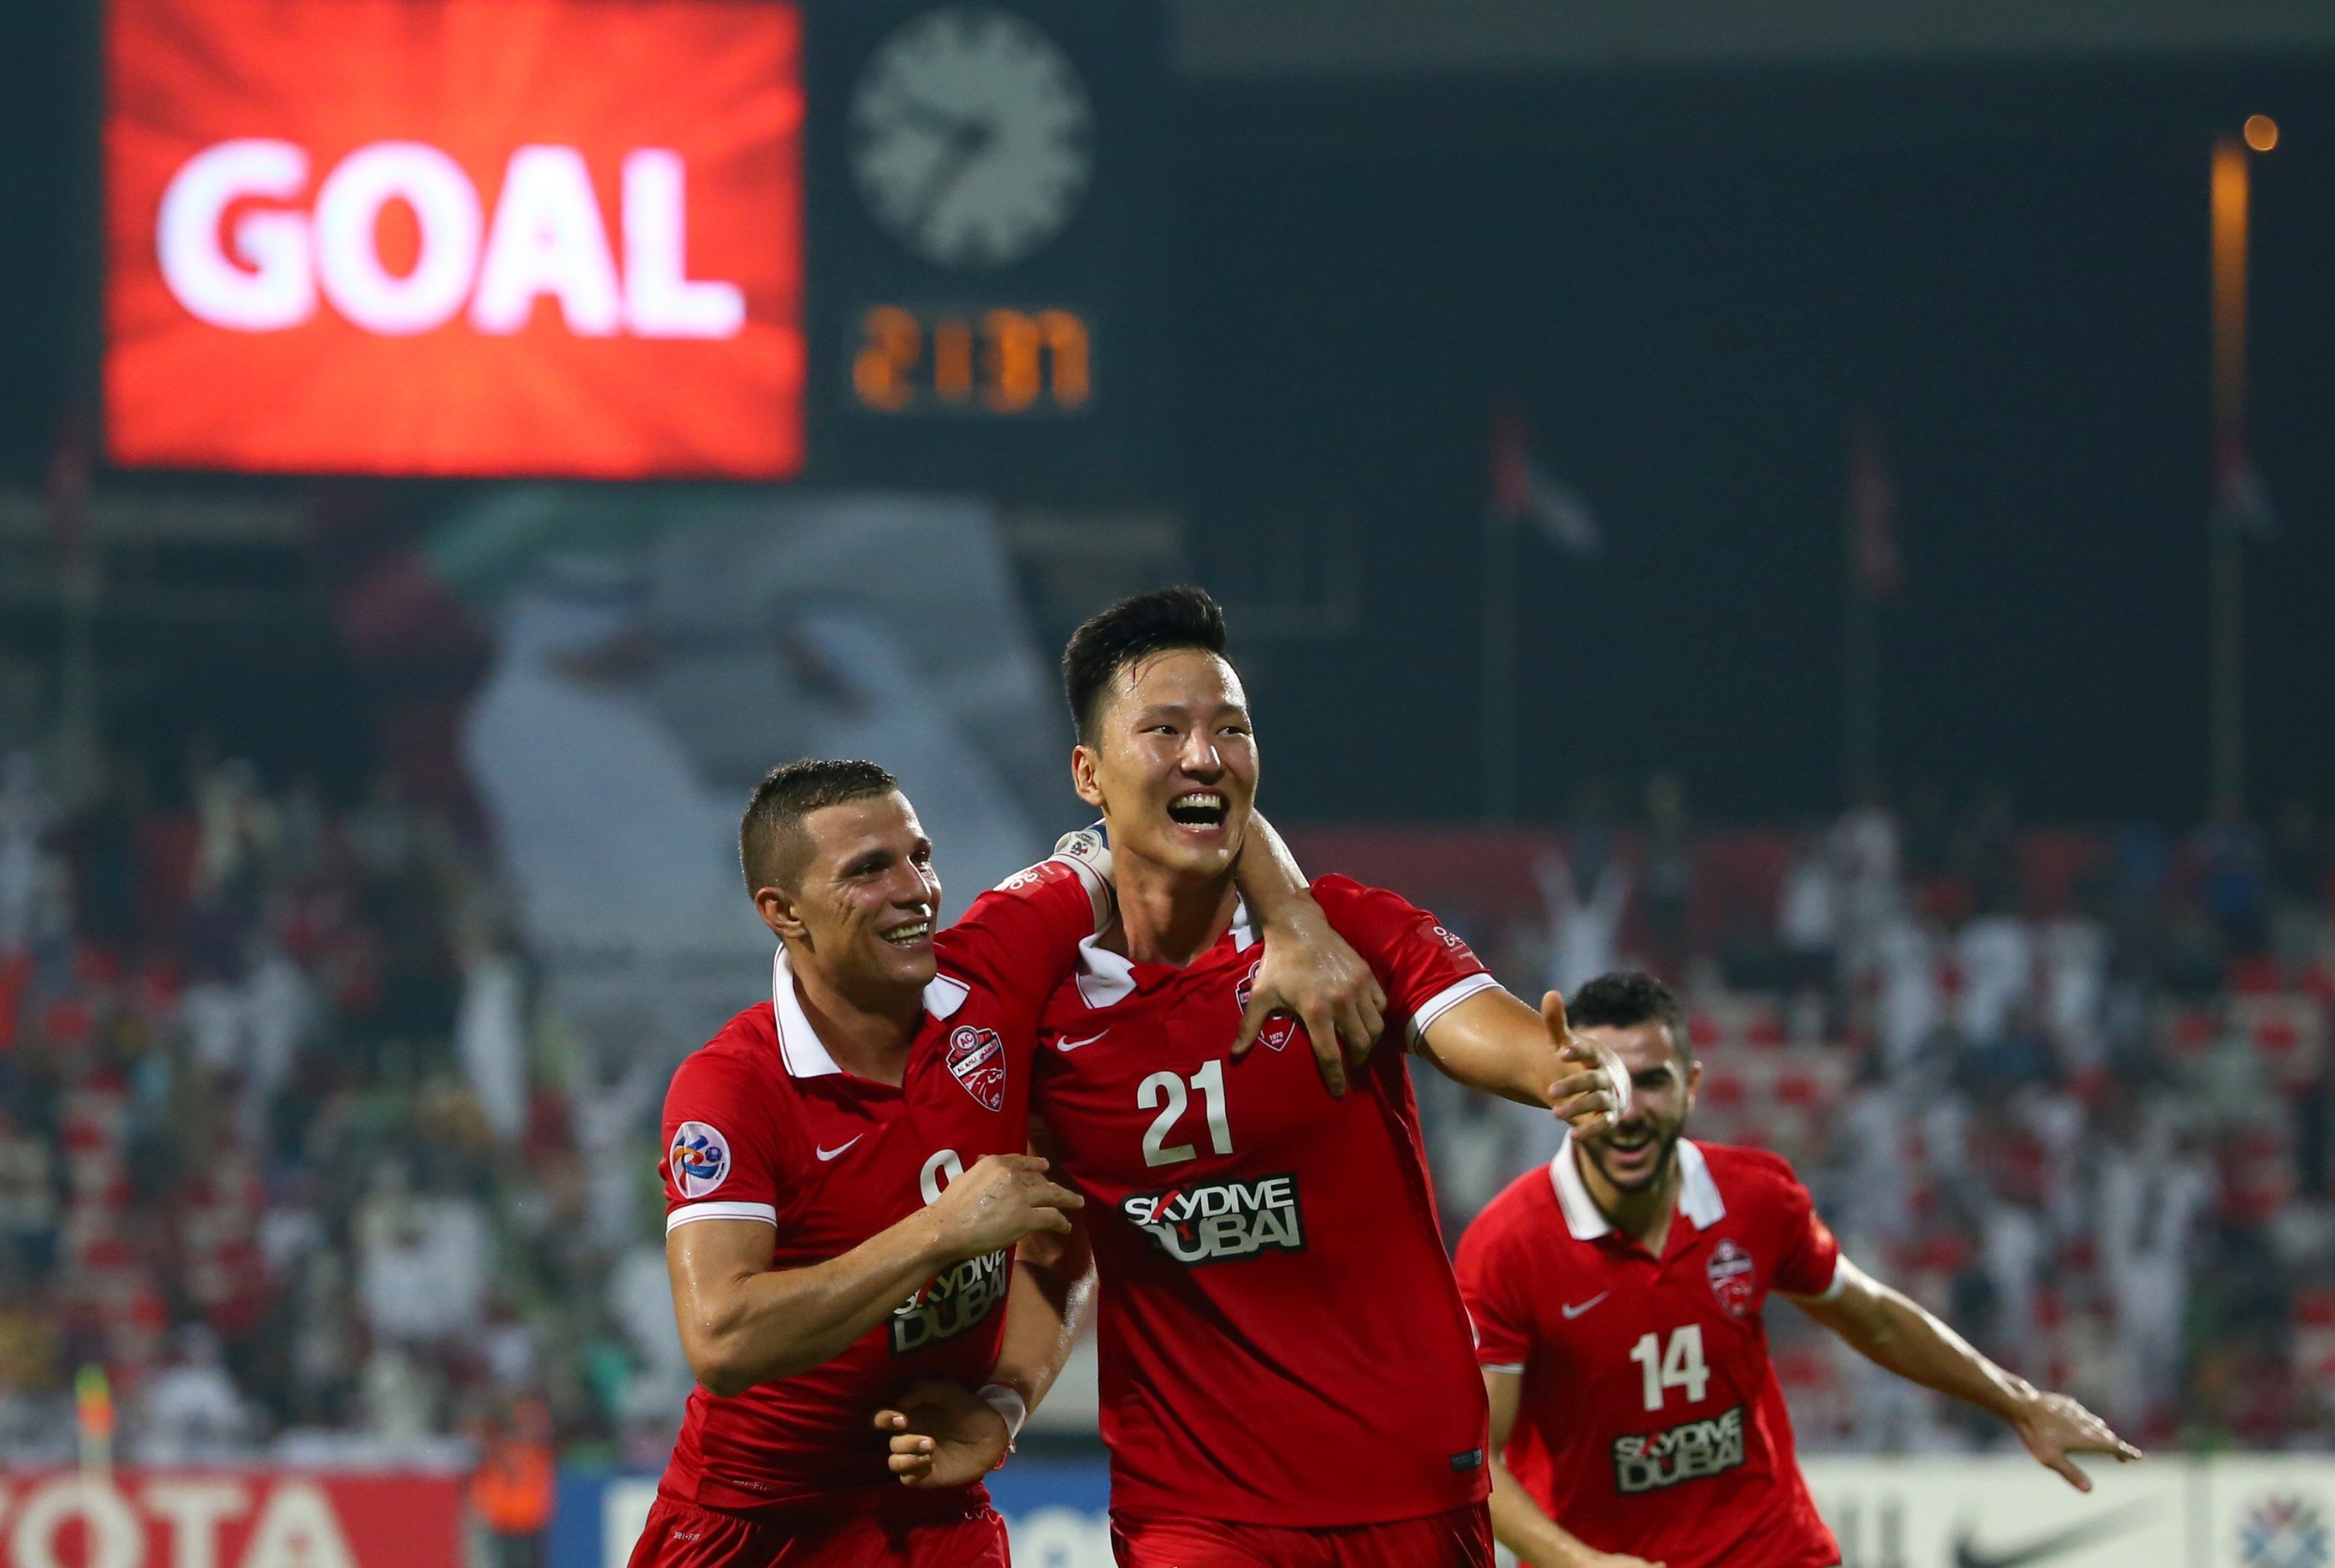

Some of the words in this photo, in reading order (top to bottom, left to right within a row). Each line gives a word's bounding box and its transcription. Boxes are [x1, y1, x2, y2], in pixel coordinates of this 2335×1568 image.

[155, 137, 746, 339] GOAL
[960, 1034, 974, 1047] AC
[1136, 1059, 1234, 1167] 21
[1125, 1178, 1294, 1226] SKYDIVE
[1629, 1324, 1710, 1412] 14
[1614, 1407, 1742, 1458] SKYDIVE
[1617, 1432, 1745, 1493] DUBAI
[0, 1477, 362, 1568] OTA
